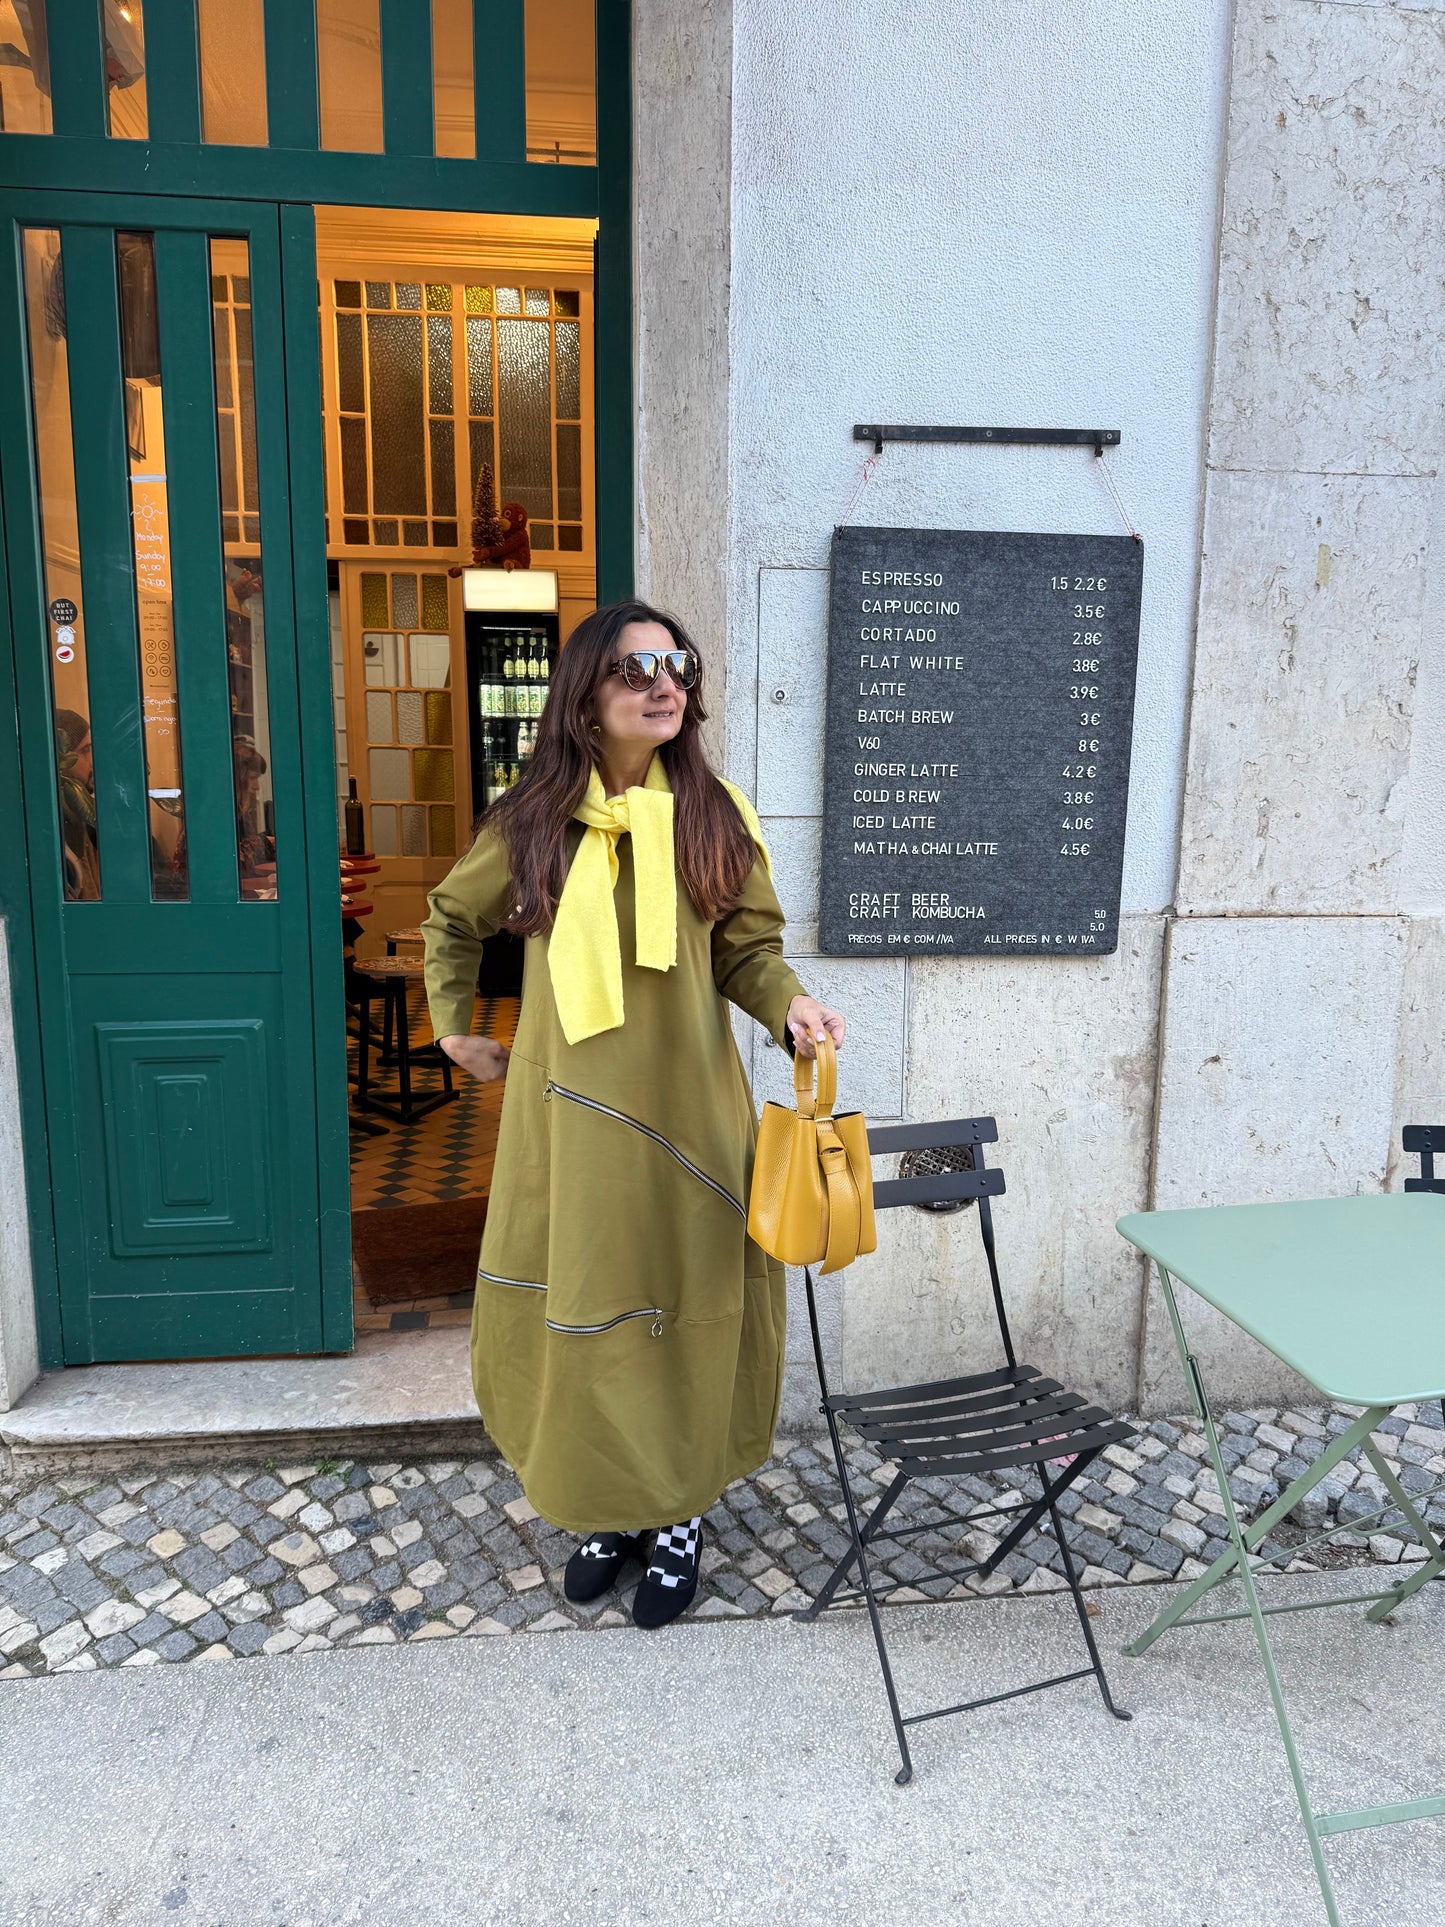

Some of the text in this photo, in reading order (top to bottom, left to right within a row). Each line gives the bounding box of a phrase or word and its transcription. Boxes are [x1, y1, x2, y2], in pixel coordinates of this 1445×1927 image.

[135, 550, 165, 563] Sunday
[861, 570, 943, 587] ESPRESSO
[1051, 576, 1068, 590] 1.5
[861, 599, 1105, 618] CAPPUCCINO 3.5€
[860, 627, 1102, 645] CORTADO 2.8€
[860, 655, 900, 669] FLAT
[909, 656, 964, 670] WHITE
[859, 682, 1099, 699] LATTE 3.9€
[857, 709, 905, 723] BATCH
[911, 711, 954, 724] BREW
[858, 736, 880, 750] V60
[854, 763, 906, 777] GINGER
[911, 764, 959, 777] LATTE
[853, 789, 1094, 804] COLD BREW 3.8€
[852, 815, 1094, 830] ICED LATTE 4.0€
[854, 842, 1090, 856] MATHA & CHAI LATTE 4.5€
[849, 893, 950, 906] CRAFT BEER
[849, 906, 986, 919] CRAFT KOMBUCHA
[1090, 922, 1105, 932] 5.0
[848, 933, 882, 944] PRECOS
[887, 934, 901, 944] EM
[903, 934, 911, 944] €
[983, 934, 1002, 944] ALL
[1005, 934, 1038, 944] PRICES
[1055, 934, 1063, 944] €
[1068, 934, 1078, 944] W
[1081, 934, 1096, 944] IVA
